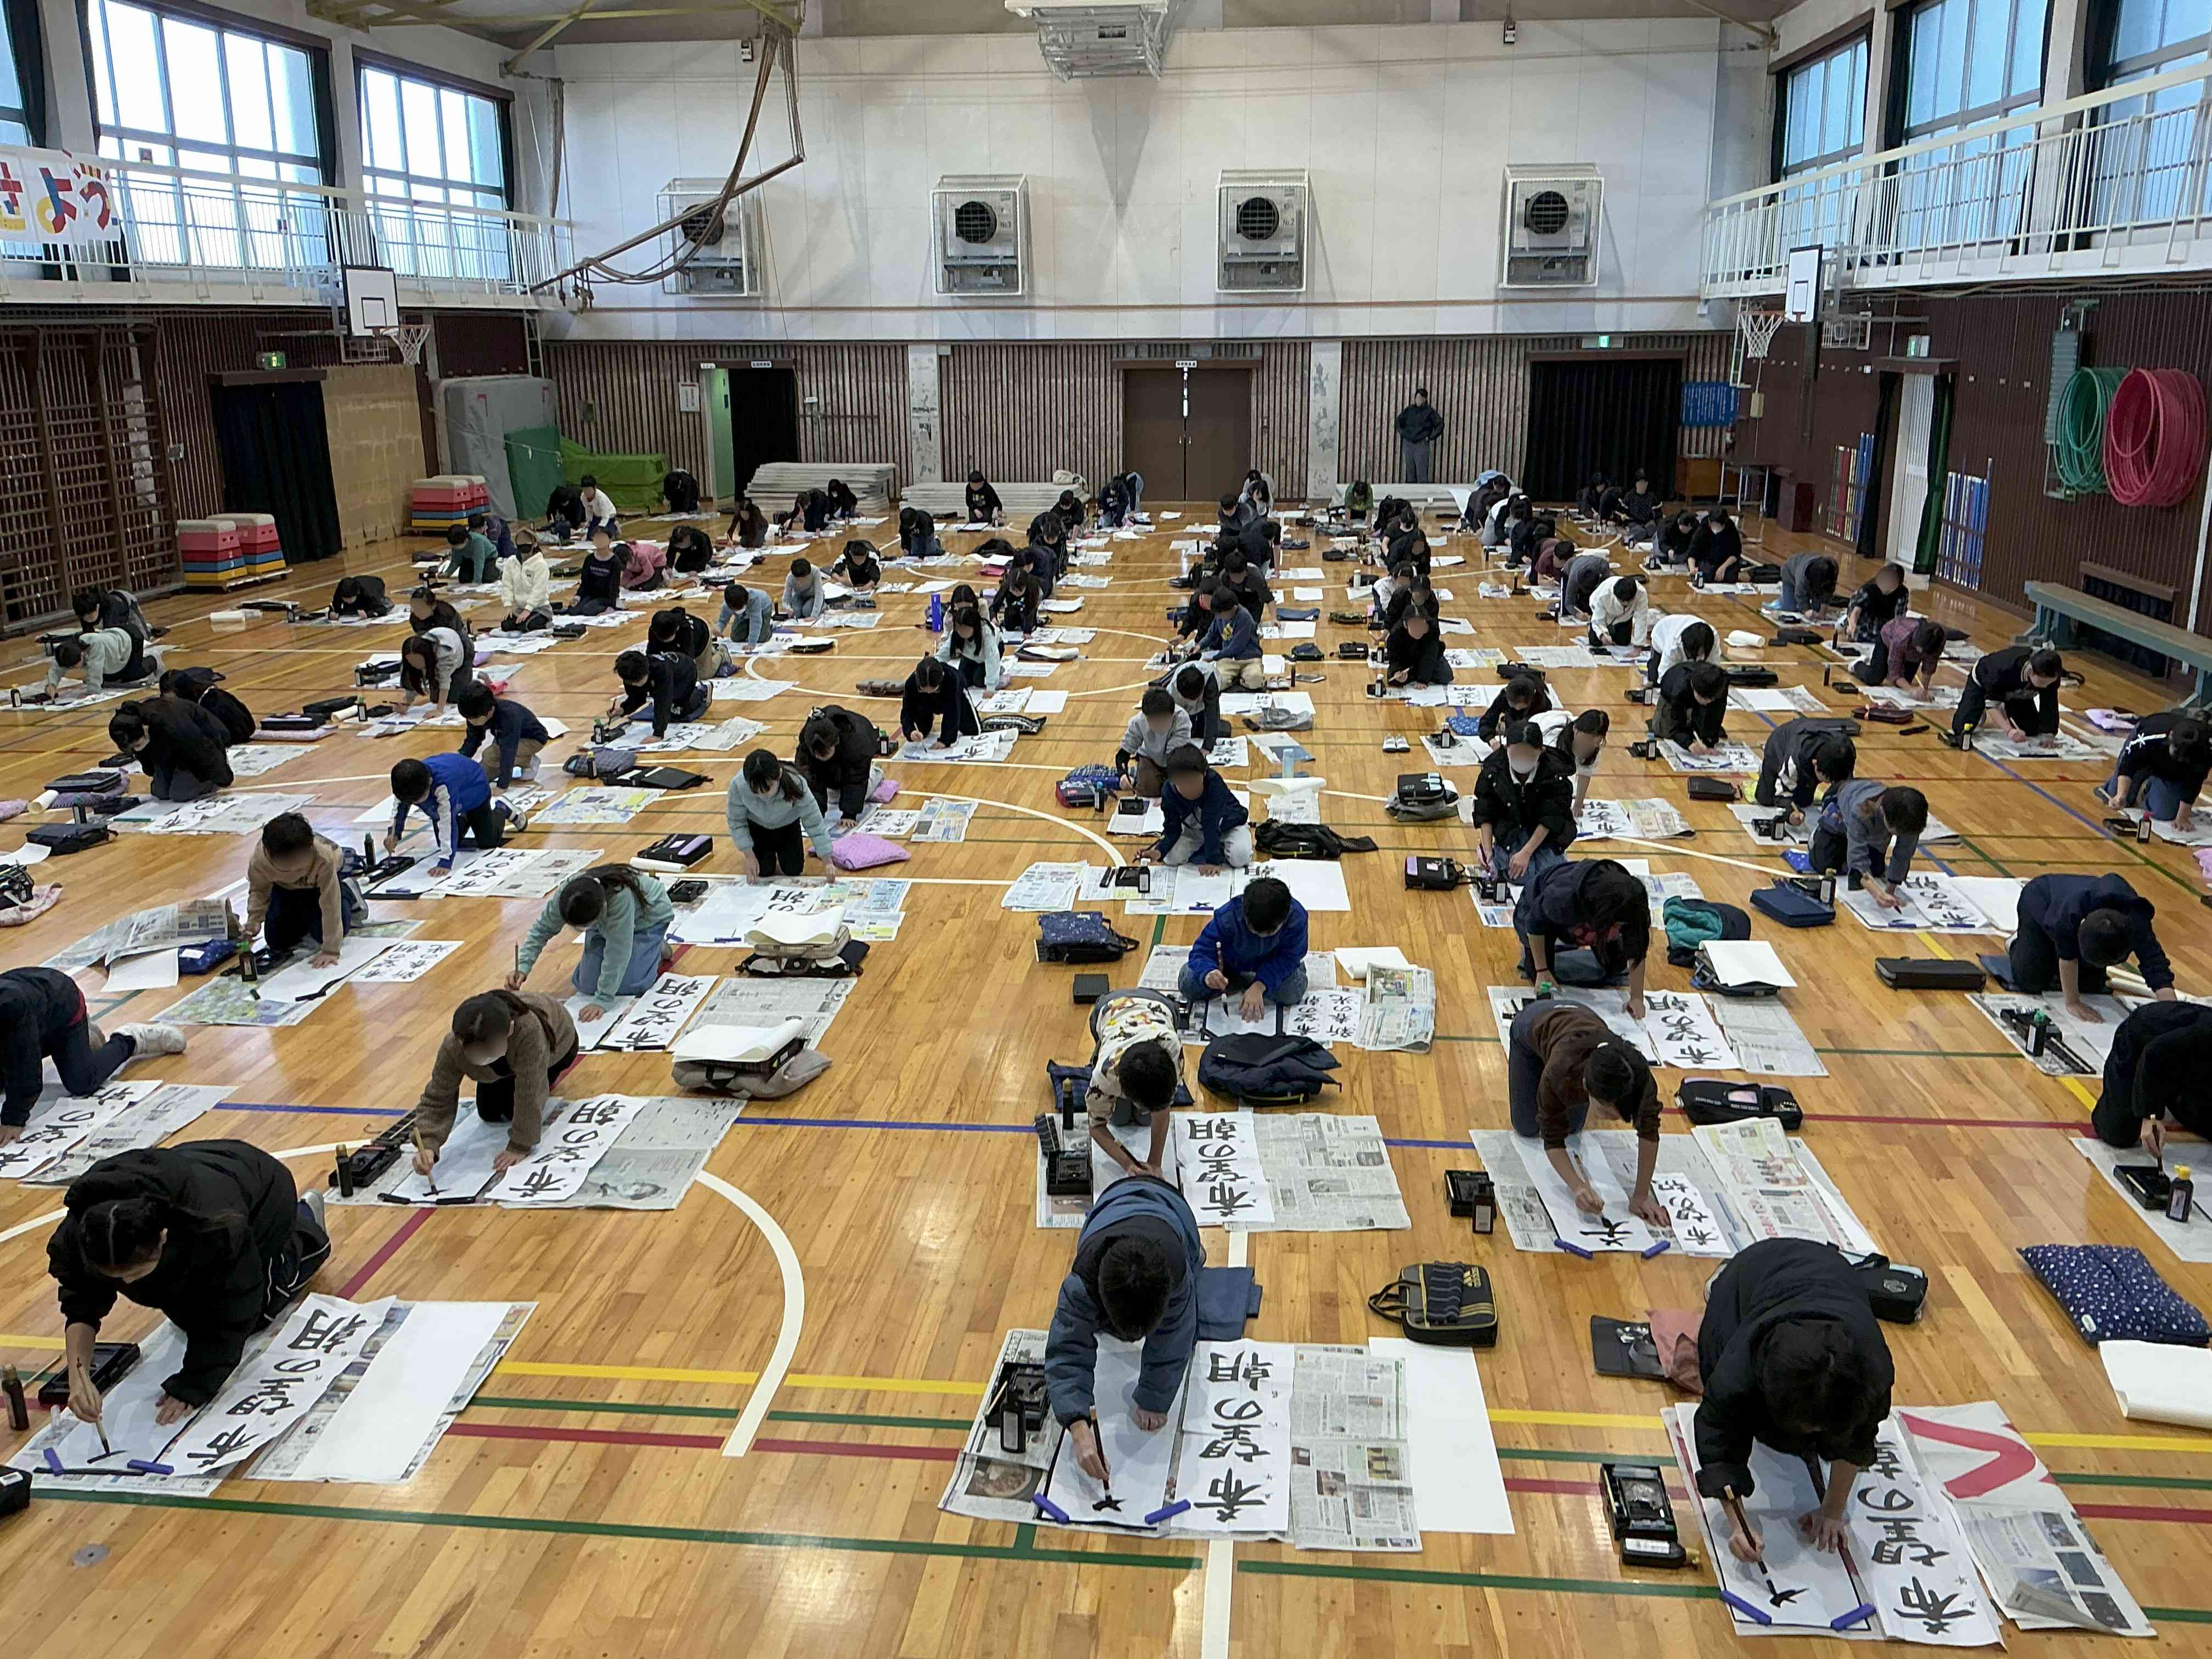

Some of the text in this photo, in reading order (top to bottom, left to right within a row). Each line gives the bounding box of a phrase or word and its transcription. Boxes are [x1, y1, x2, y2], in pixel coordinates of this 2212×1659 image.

[615, 978, 704, 1049] 希望の朝
[509, 1099, 626, 1198] 希望の朝
[1187, 1118, 1256, 1217] 希望の朝
[187, 1309, 368, 1470] 希望の朝
[1193, 1350, 1274, 1522] 希望の朝
